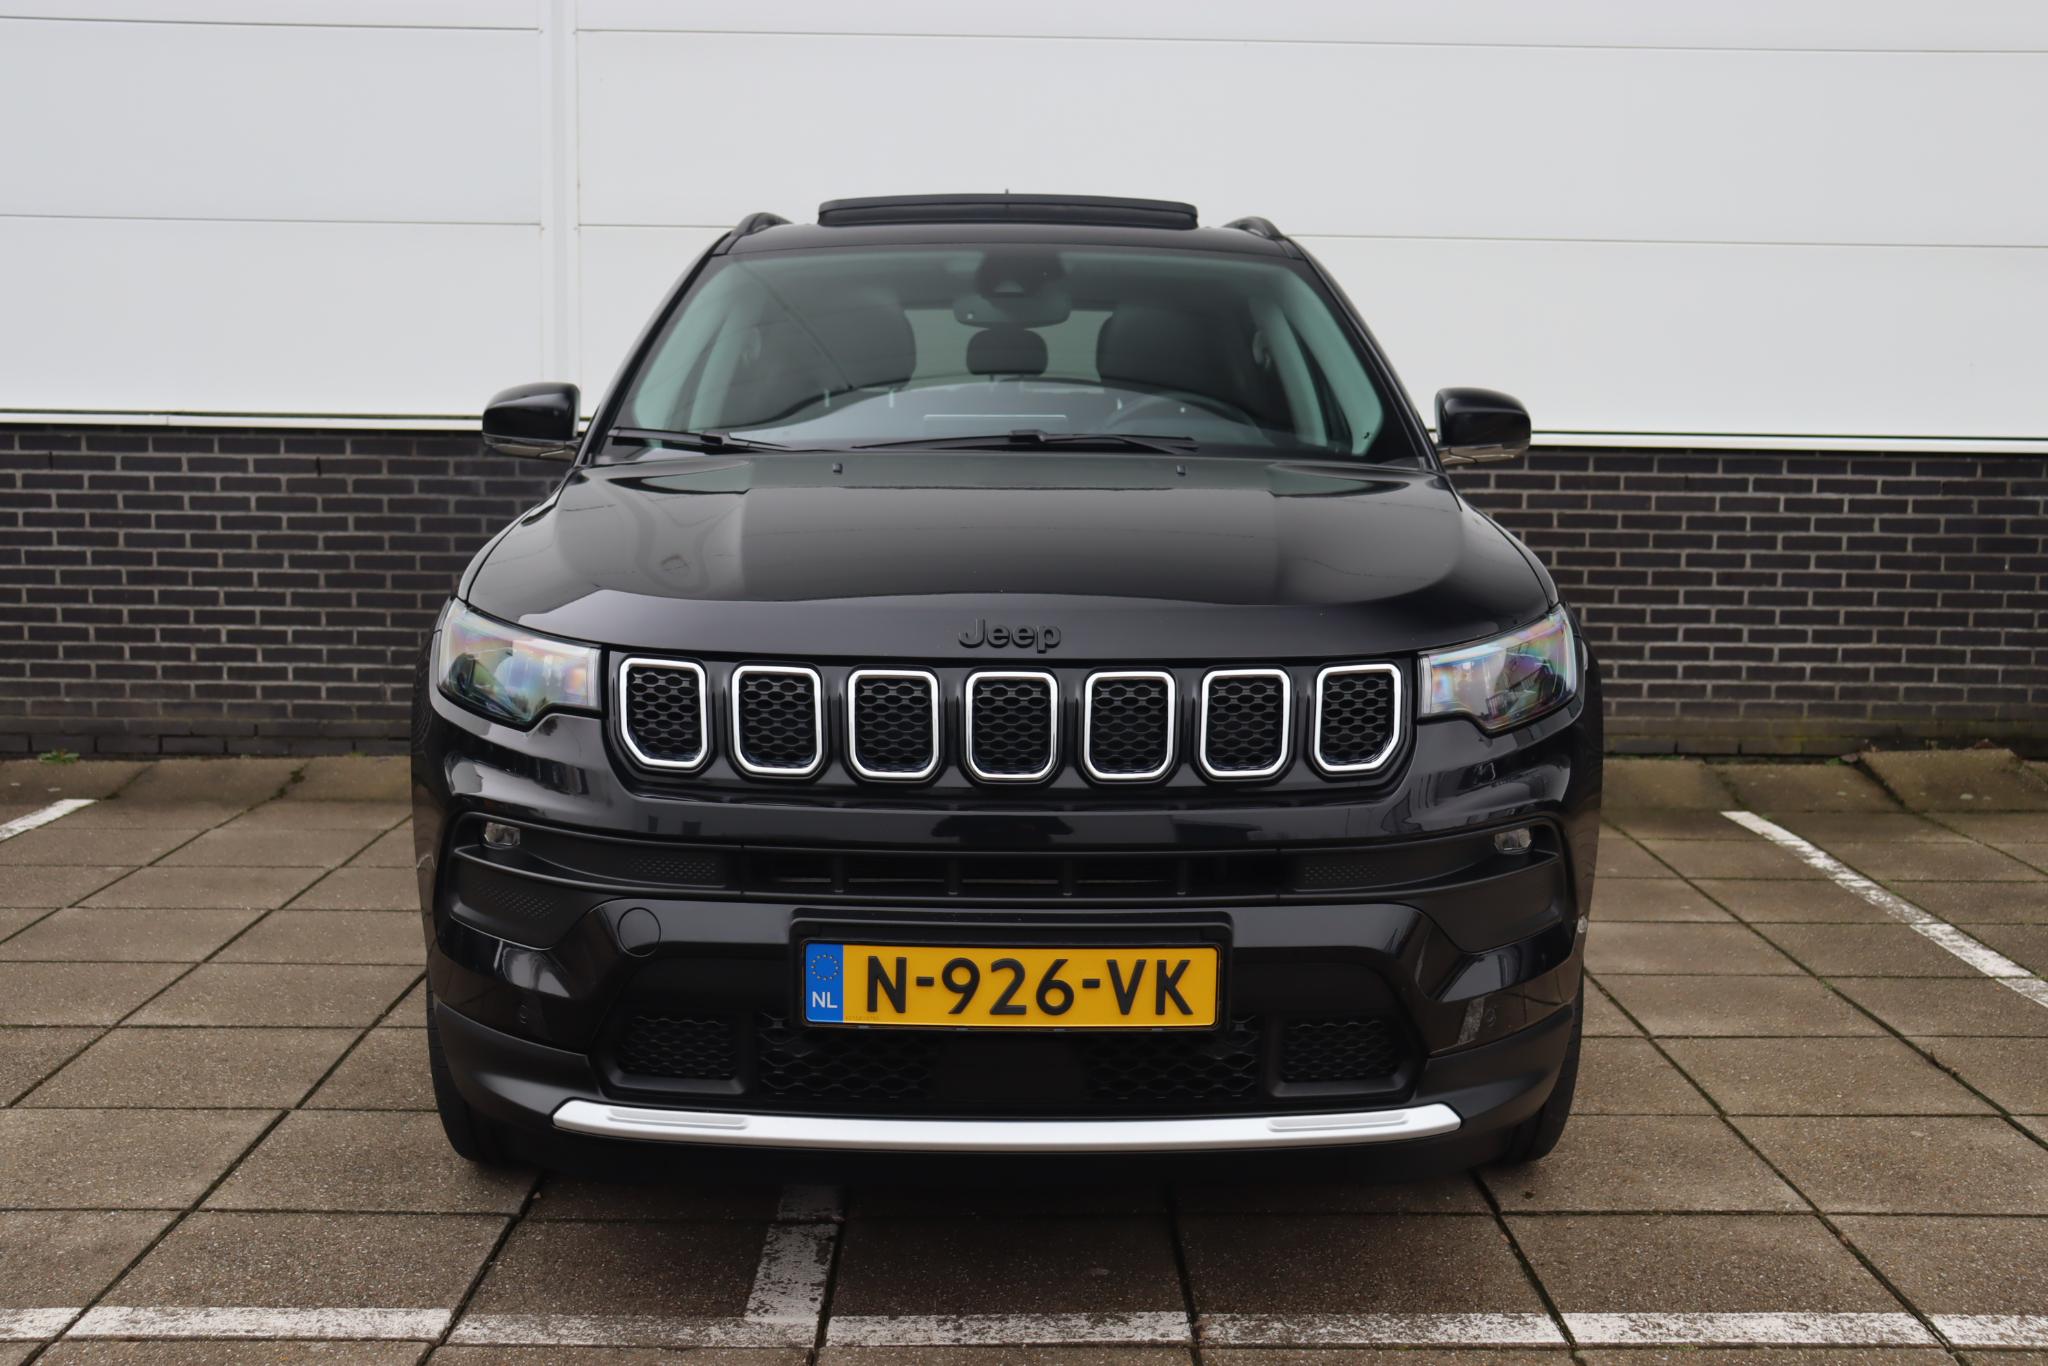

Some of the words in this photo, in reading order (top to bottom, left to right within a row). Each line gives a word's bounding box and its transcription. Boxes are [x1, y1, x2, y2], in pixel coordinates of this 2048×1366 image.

[958, 618, 1061, 654] Jeep
[812, 991, 838, 1009] NL
[867, 955, 1193, 1016] N-926-VK
